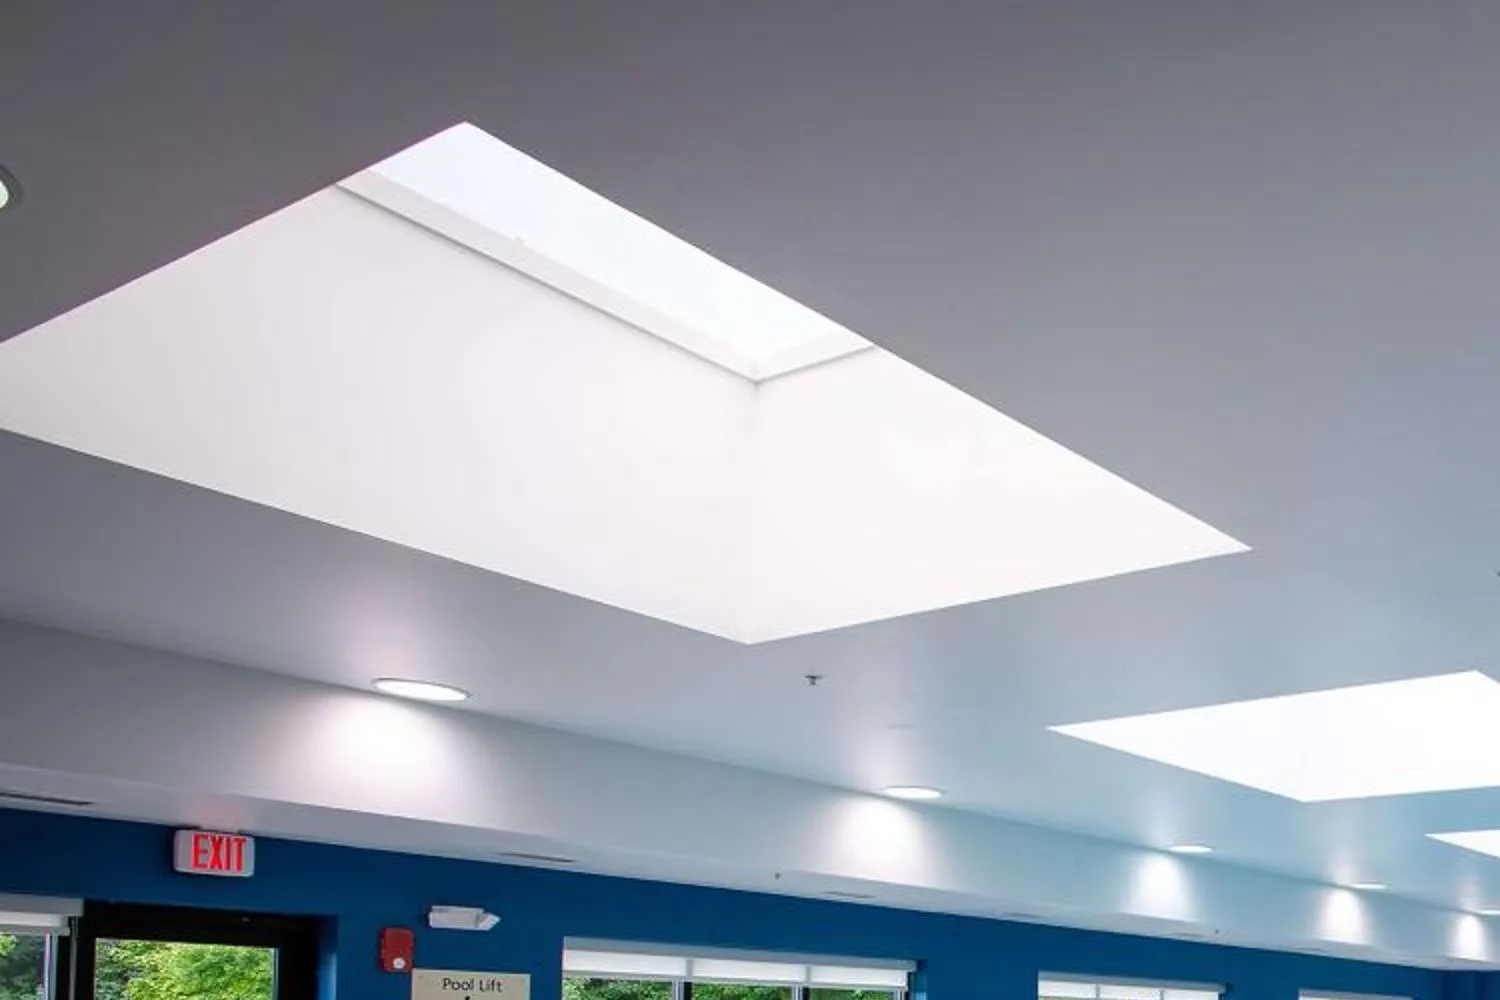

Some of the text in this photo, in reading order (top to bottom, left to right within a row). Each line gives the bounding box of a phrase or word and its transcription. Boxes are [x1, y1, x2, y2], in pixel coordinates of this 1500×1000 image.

[192, 832, 247, 873] EXIT
[443, 978, 502, 992] Pool Lift
